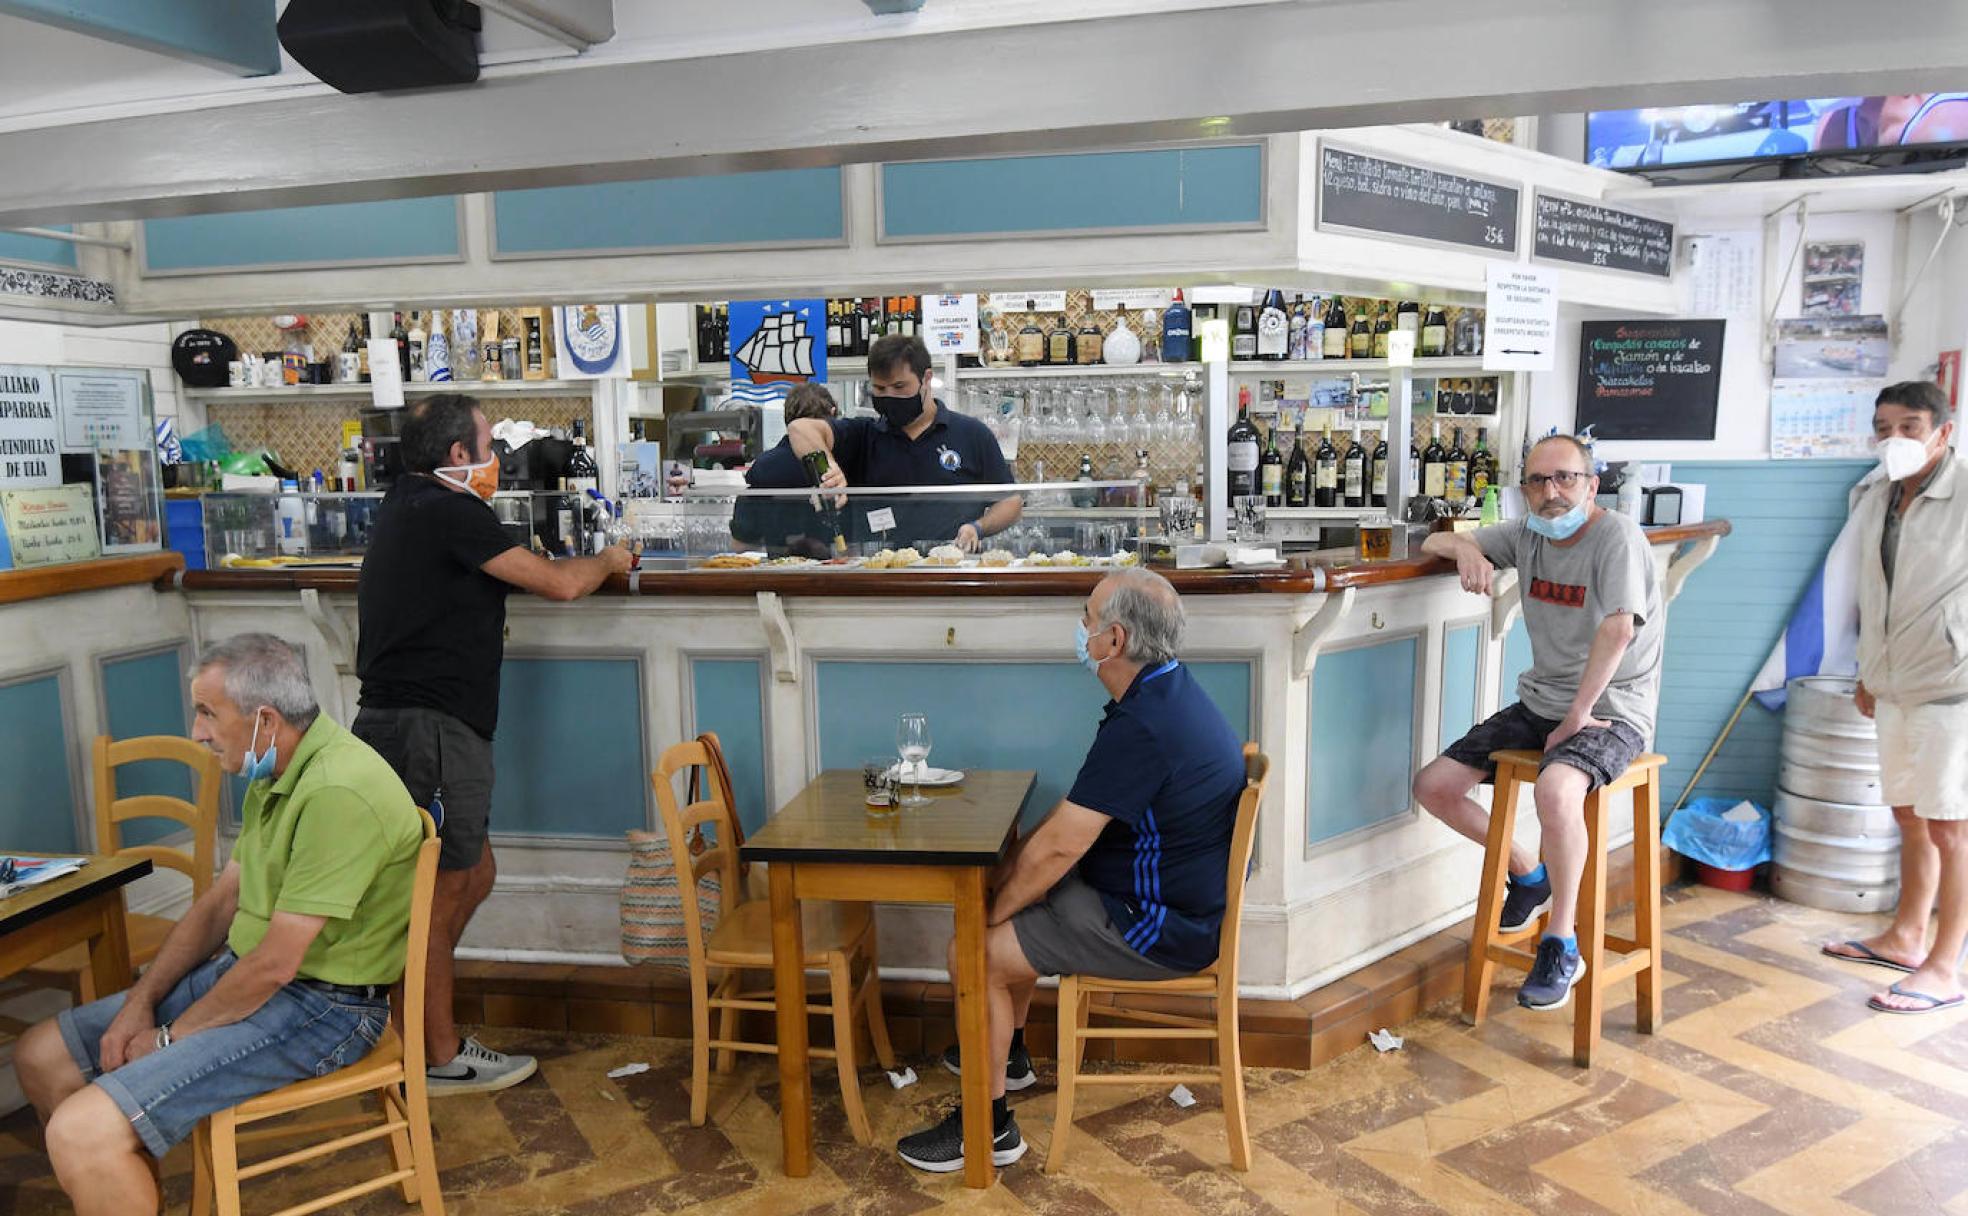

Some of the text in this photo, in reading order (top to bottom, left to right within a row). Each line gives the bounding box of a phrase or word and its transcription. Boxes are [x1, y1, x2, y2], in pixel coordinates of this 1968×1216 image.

[1485, 225, 1505, 245] 25€
[1688, 338, 1702, 349] de
[1614, 349, 1660, 365] Jamón
[0, 438, 55, 455] UINDILLAS
[6, 461, 20, 478] DE
